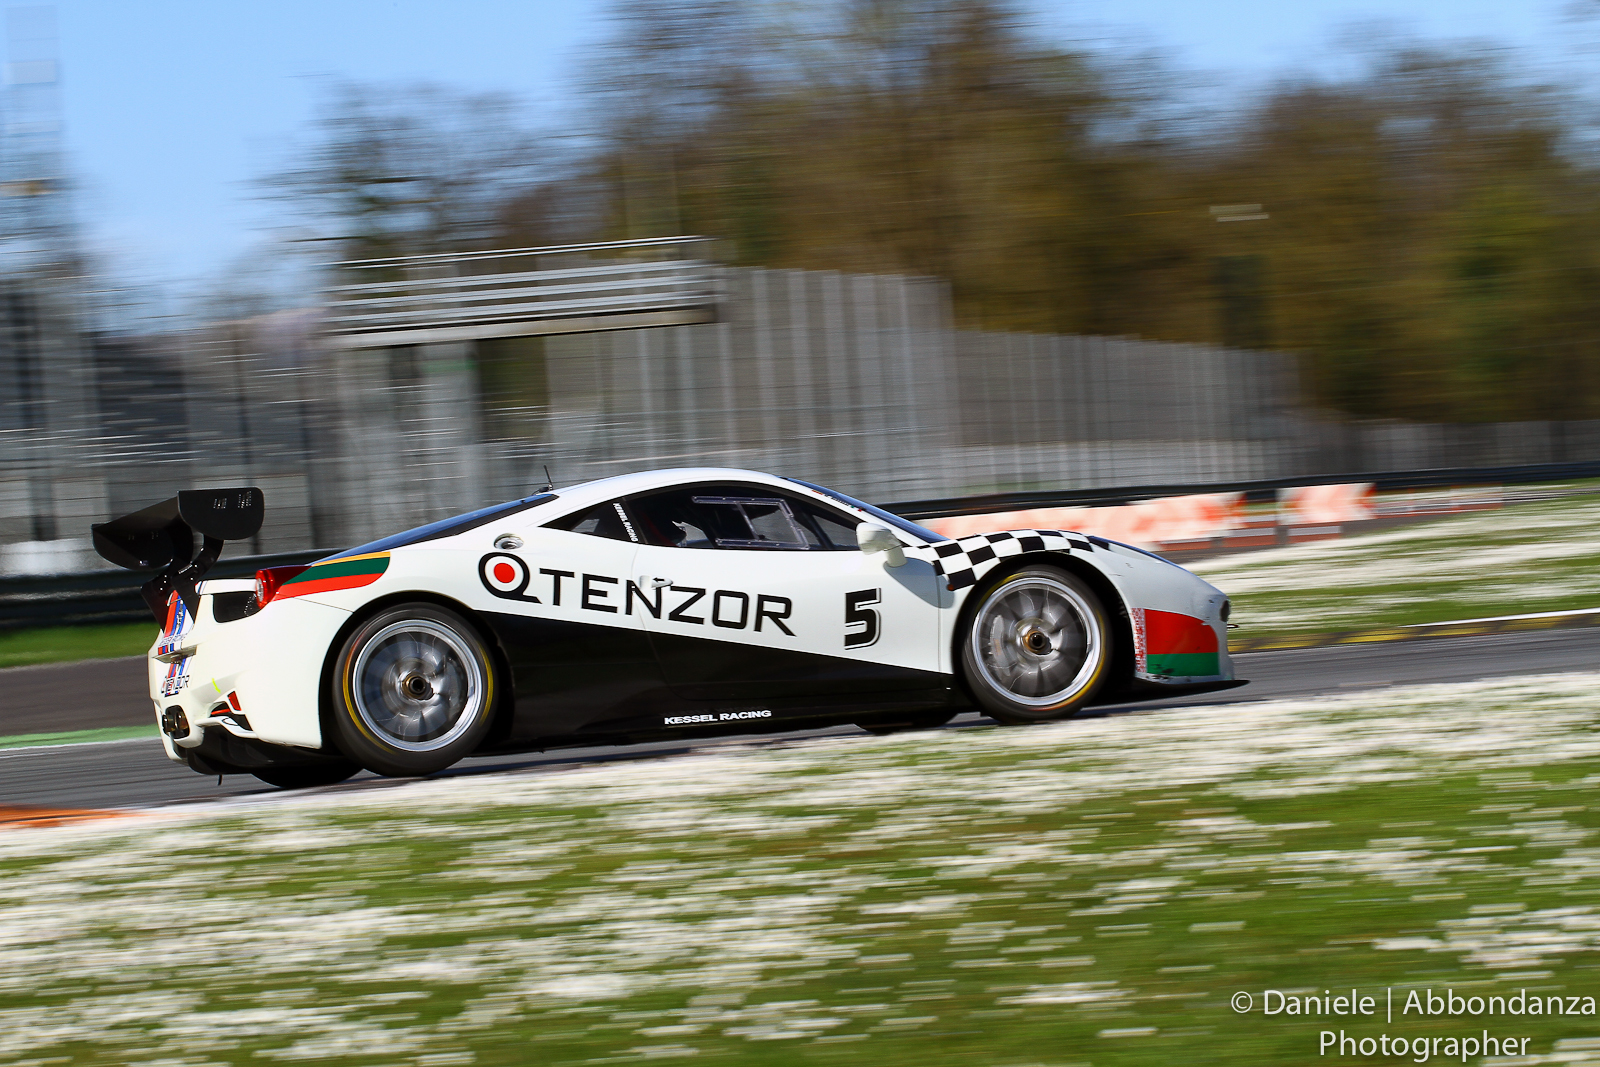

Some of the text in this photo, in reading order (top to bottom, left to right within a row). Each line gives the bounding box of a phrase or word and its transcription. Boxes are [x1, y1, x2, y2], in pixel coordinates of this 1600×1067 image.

[844, 587, 881, 650] 5
[664, 709, 772, 725] KESSEL RACING
